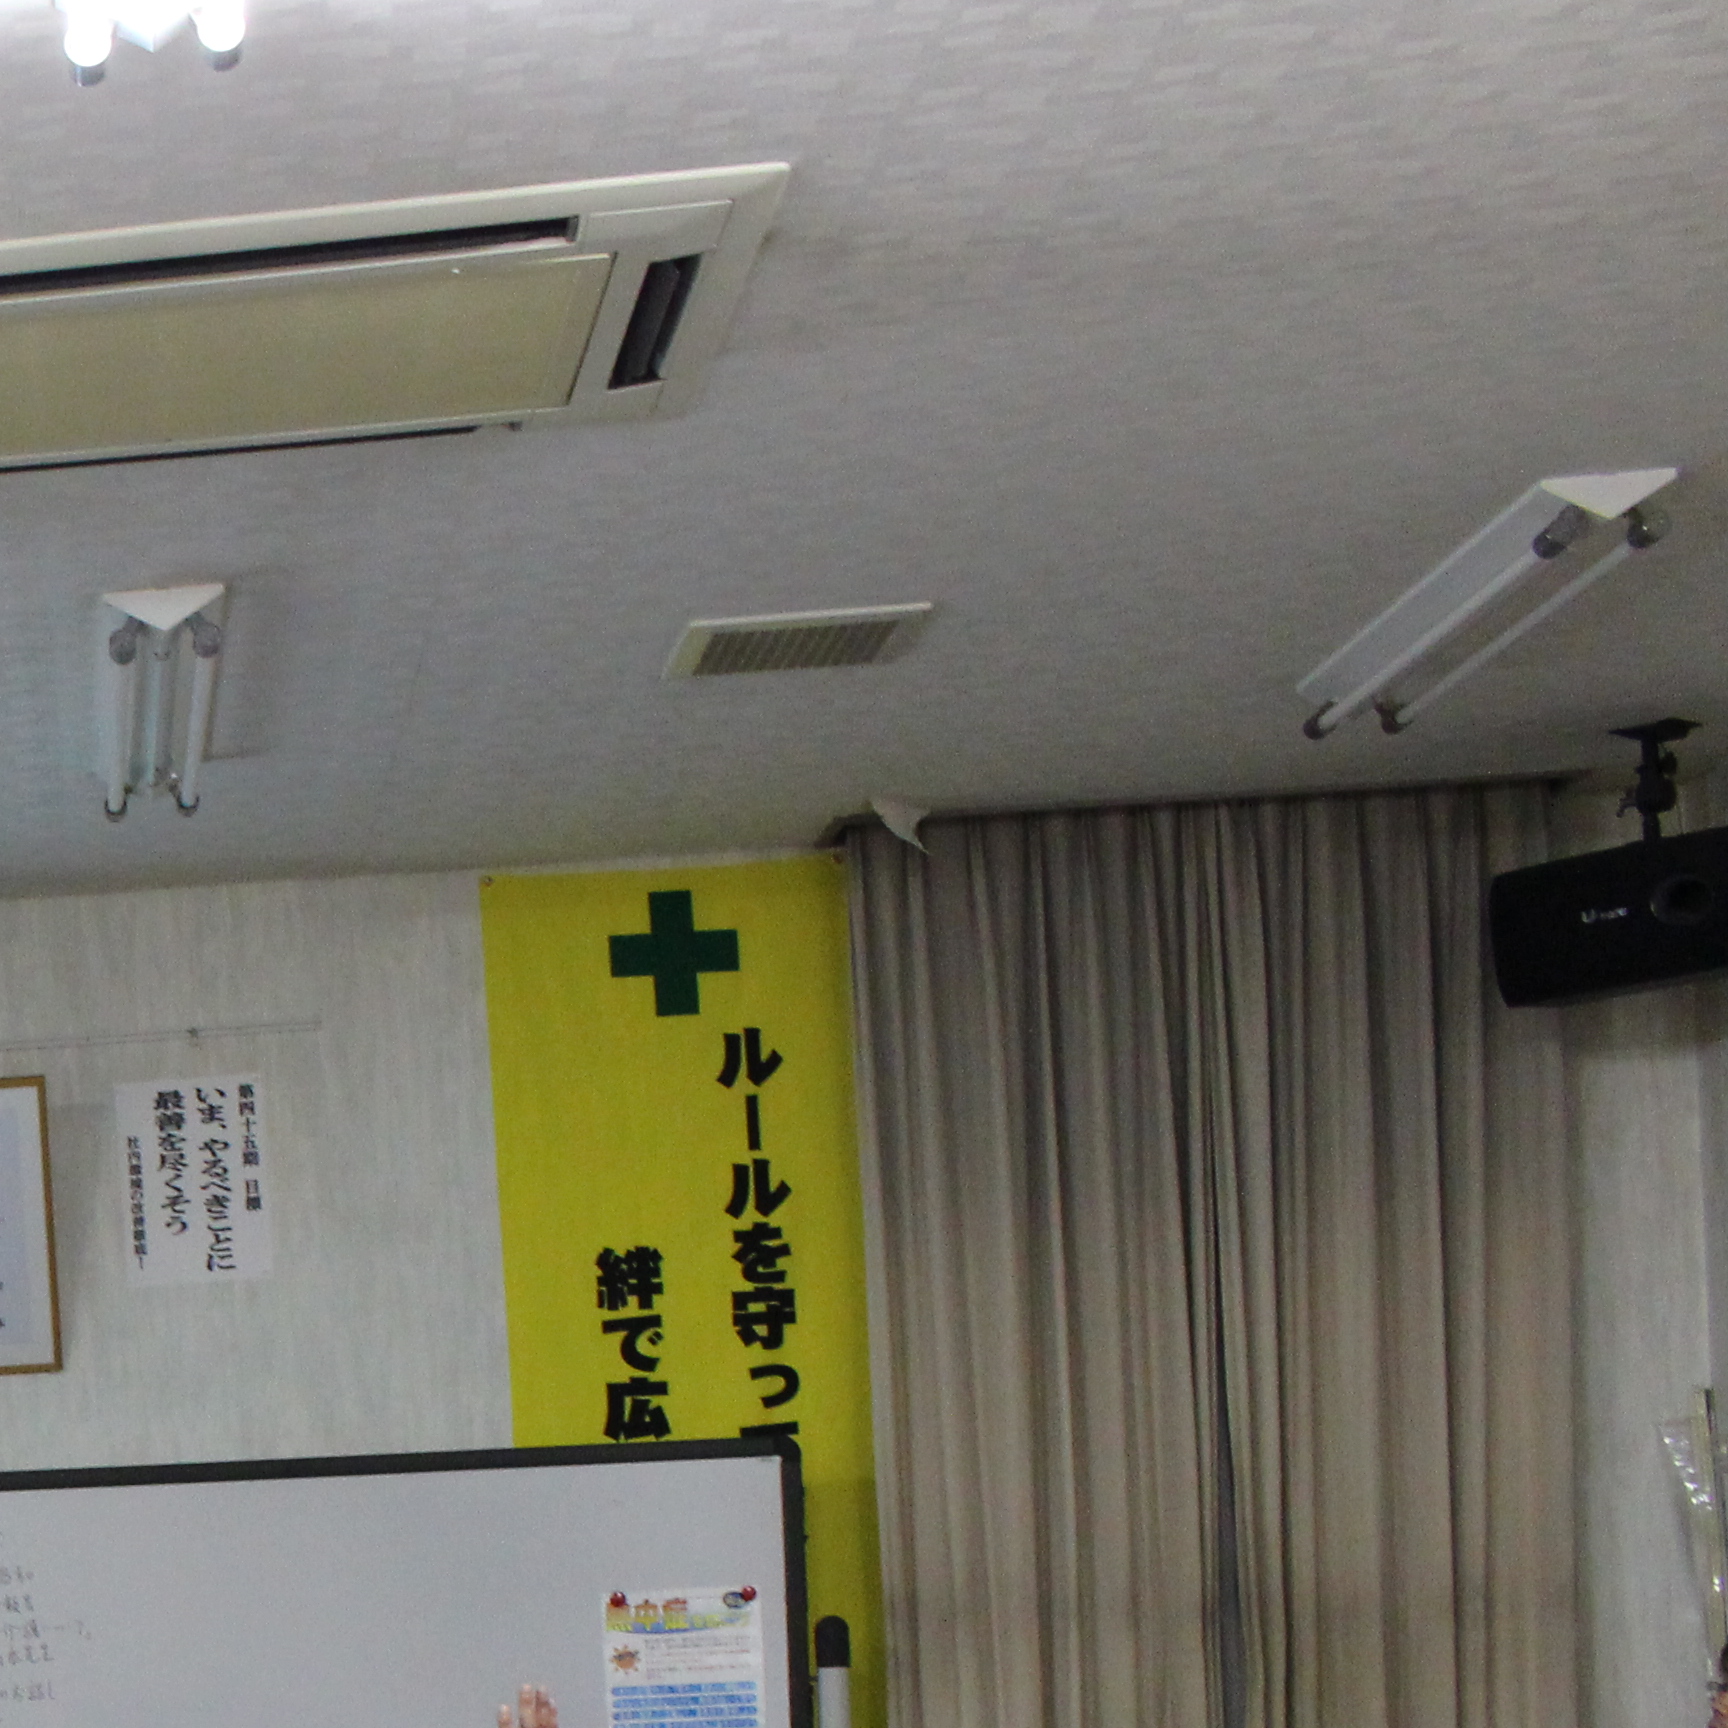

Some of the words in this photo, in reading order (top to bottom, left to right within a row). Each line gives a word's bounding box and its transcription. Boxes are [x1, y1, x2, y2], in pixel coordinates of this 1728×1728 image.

[154, 1089, 191, 1236] 最善を尽くそう
[195, 1087, 237, 1271] いま、やるべきことに
[595, 1246, 671, 1442] 絆で広
